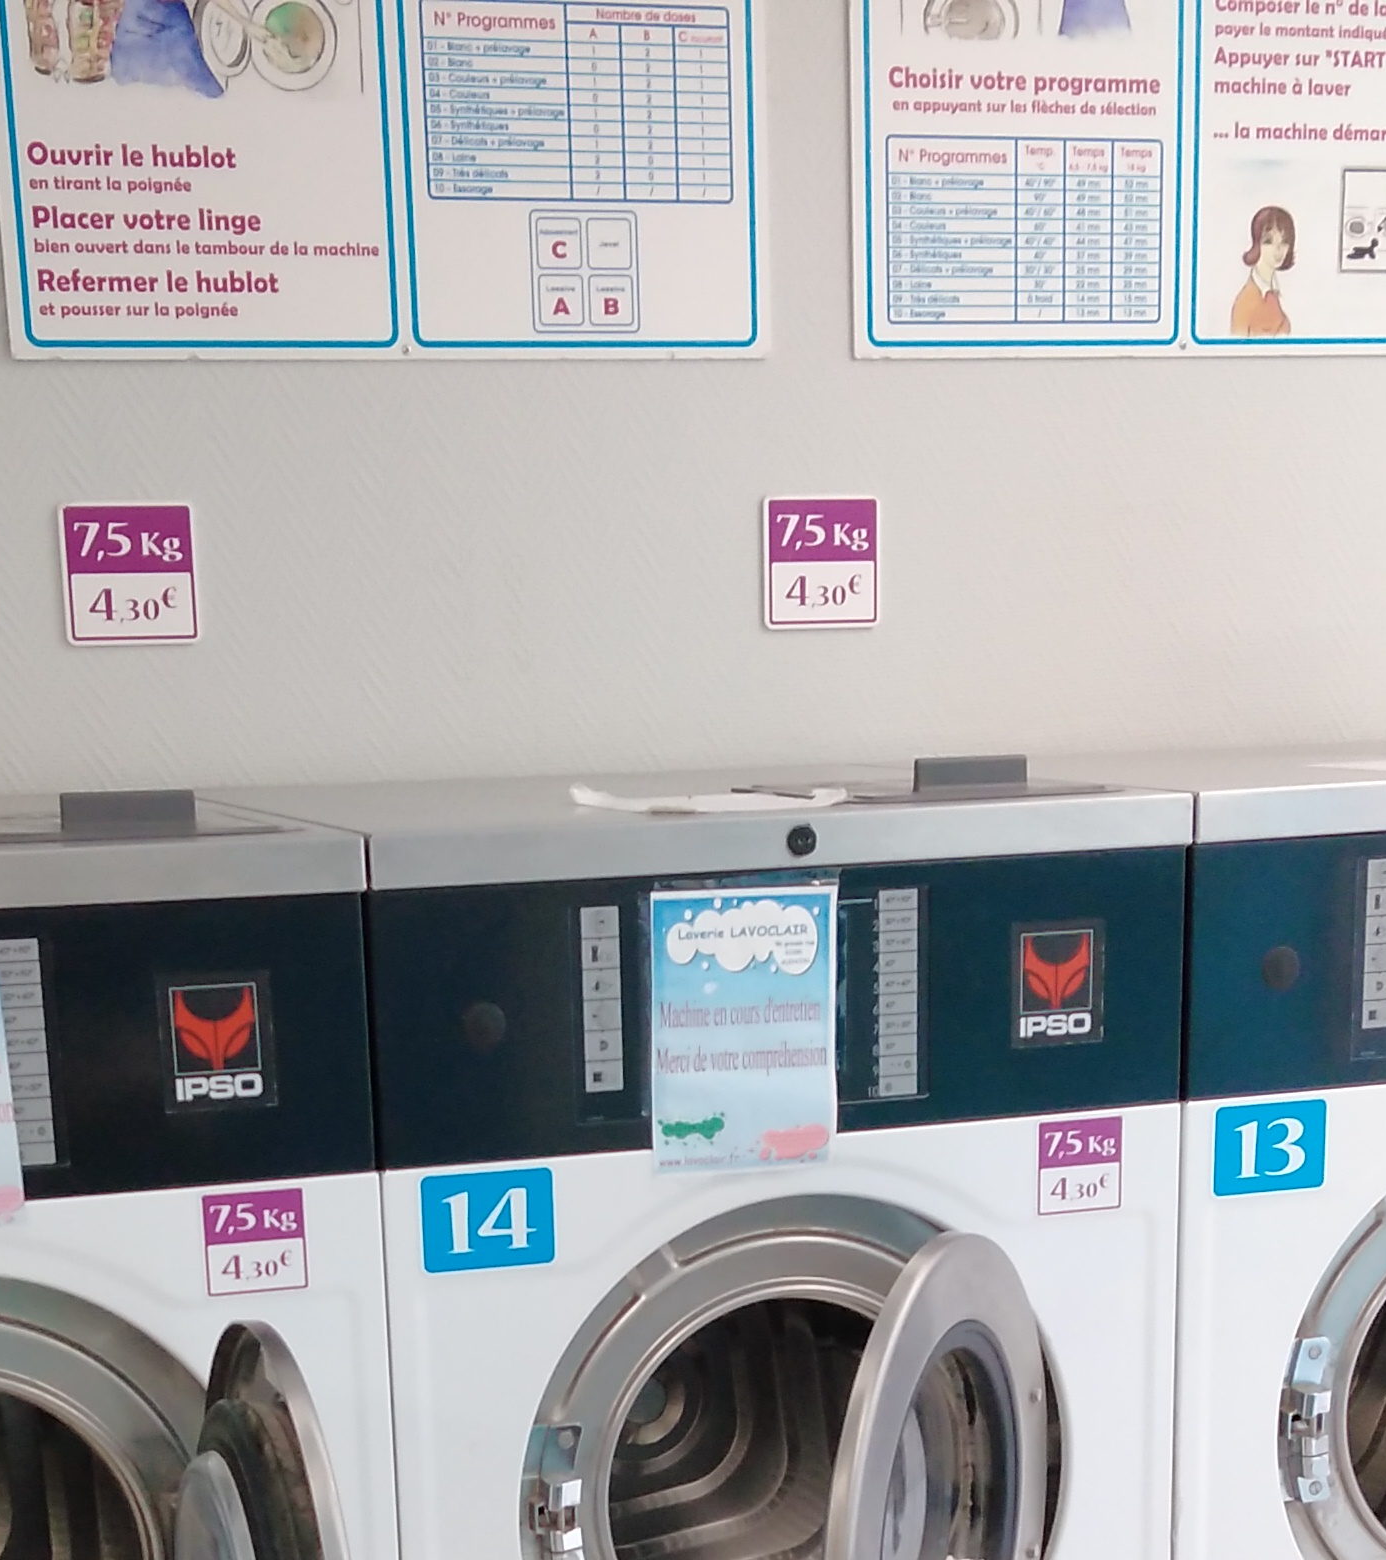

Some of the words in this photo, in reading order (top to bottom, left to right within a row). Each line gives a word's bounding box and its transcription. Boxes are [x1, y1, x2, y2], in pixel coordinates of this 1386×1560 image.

[596, 8, 642, 22] Nombre
[645, 11, 660, 22] de
[663, 11, 696, 23] doses
[1306, 0, 1320, 14] le
[1348, 0, 1369, 17] de
[434, 10, 452, 27] N°
[457, 12, 556, 31] Programmes
[1215, 24, 1255, 38] payer
[1259, 21, 1271, 36] le
[1275, 24, 1334, 38] montant
[589, 28, 598, 39] A
[644, 30, 650, 41] B
[1214, 46, 1290, 69] Appuyer
[1295, 53, 1321, 66] sur
[888, 65, 964, 89] Choisir
[970, 70, 1027, 91] votre
[1033, 75, 1161, 96] programme
[1214, 77, 1287, 95] machine
[1292, 77, 1303, 95] à
[1308, 78, 1352, 97] laver
[892, 100, 910, 111] en
[913, 99, 982, 115] appuyant
[987, 101, 1006, 113] sur
[1010, 99, 1027, 113] les
[1031, 99, 1076, 115] flèches
[1080, 100, 1097, 115] de
[1101, 101, 1157, 116] sélection
[1234, 121, 1251, 139] la
[1256, 122, 1328, 140] machine
[27, 141, 113, 166] Ouvrir
[122, 143, 144, 167] le
[152, 144, 237, 169] hublot
[919, 149, 1008, 167] Programmes
[1072, 146, 1105, 159] Temps
[1121, 147, 1154, 159] Temps
[29, 178, 49, 190] en
[54, 176, 102, 191] tirant
[107, 176, 122, 191] la
[128, 176, 192, 194] poignée
[32, 205, 114, 229] Placer
[123, 209, 191, 231] votre
[198, 207, 261, 235] linge
[34, 238, 70, 253] bien
[75, 241, 129, 254] ouvert
[134, 239, 171, 254] dans
[176, 240, 190, 254] le
[195, 240, 265, 256] tambour
[270, 241, 289, 256] de
[294, 241, 309, 256] la
[314, 242, 380, 257] machine
[552, 240, 568, 259] C
[37, 268, 159, 293] Refermer
[167, 269, 188, 293] le
[196, 270, 280, 293] hublot
[39, 303, 55, 316] et
[61, 305, 121, 319] pousser
[127, 306, 150, 317] sur
[155, 302, 170, 317] la
[175, 302, 239, 320] poignée
[553, 297, 571, 316] A
[604, 297, 620, 316] B
[73, 522, 132, 562] 7,5
[141, 532, 183, 562] Kg
[776, 514, 826, 550] 7,5
[833, 523, 869, 552] Kg
[785, 573, 862, 608] 4,30€
[89, 586, 177, 624] 4,30€
[678, 928, 724, 940] Laverie
[730, 923, 808, 938] LAVOCLAIR
[660, 999, 711, 1028] Machine
[714, 1006, 728, 1026] en
[730, 1004, 762, 1025] cours
[764, 995, 821, 1023] d'entretien
[1020, 1012, 1092, 1038] IPSO
[656, 1047, 691, 1075] Merci
[693, 1045, 708, 1072] de
[710, 1050, 740, 1071] votre
[742, 1040, 828, 1077] compréhension
[175, 1073, 263, 1103] IPSO
[1044, 1130, 1083, 1160] 7,5
[1088, 1134, 1117, 1156] Kg
[1234, 1117, 1306, 1179] 13
[209, 1203, 257, 1235] 7,5
[263, 1208, 298, 1232] Kg
[441, 1187, 538, 1255] 14
